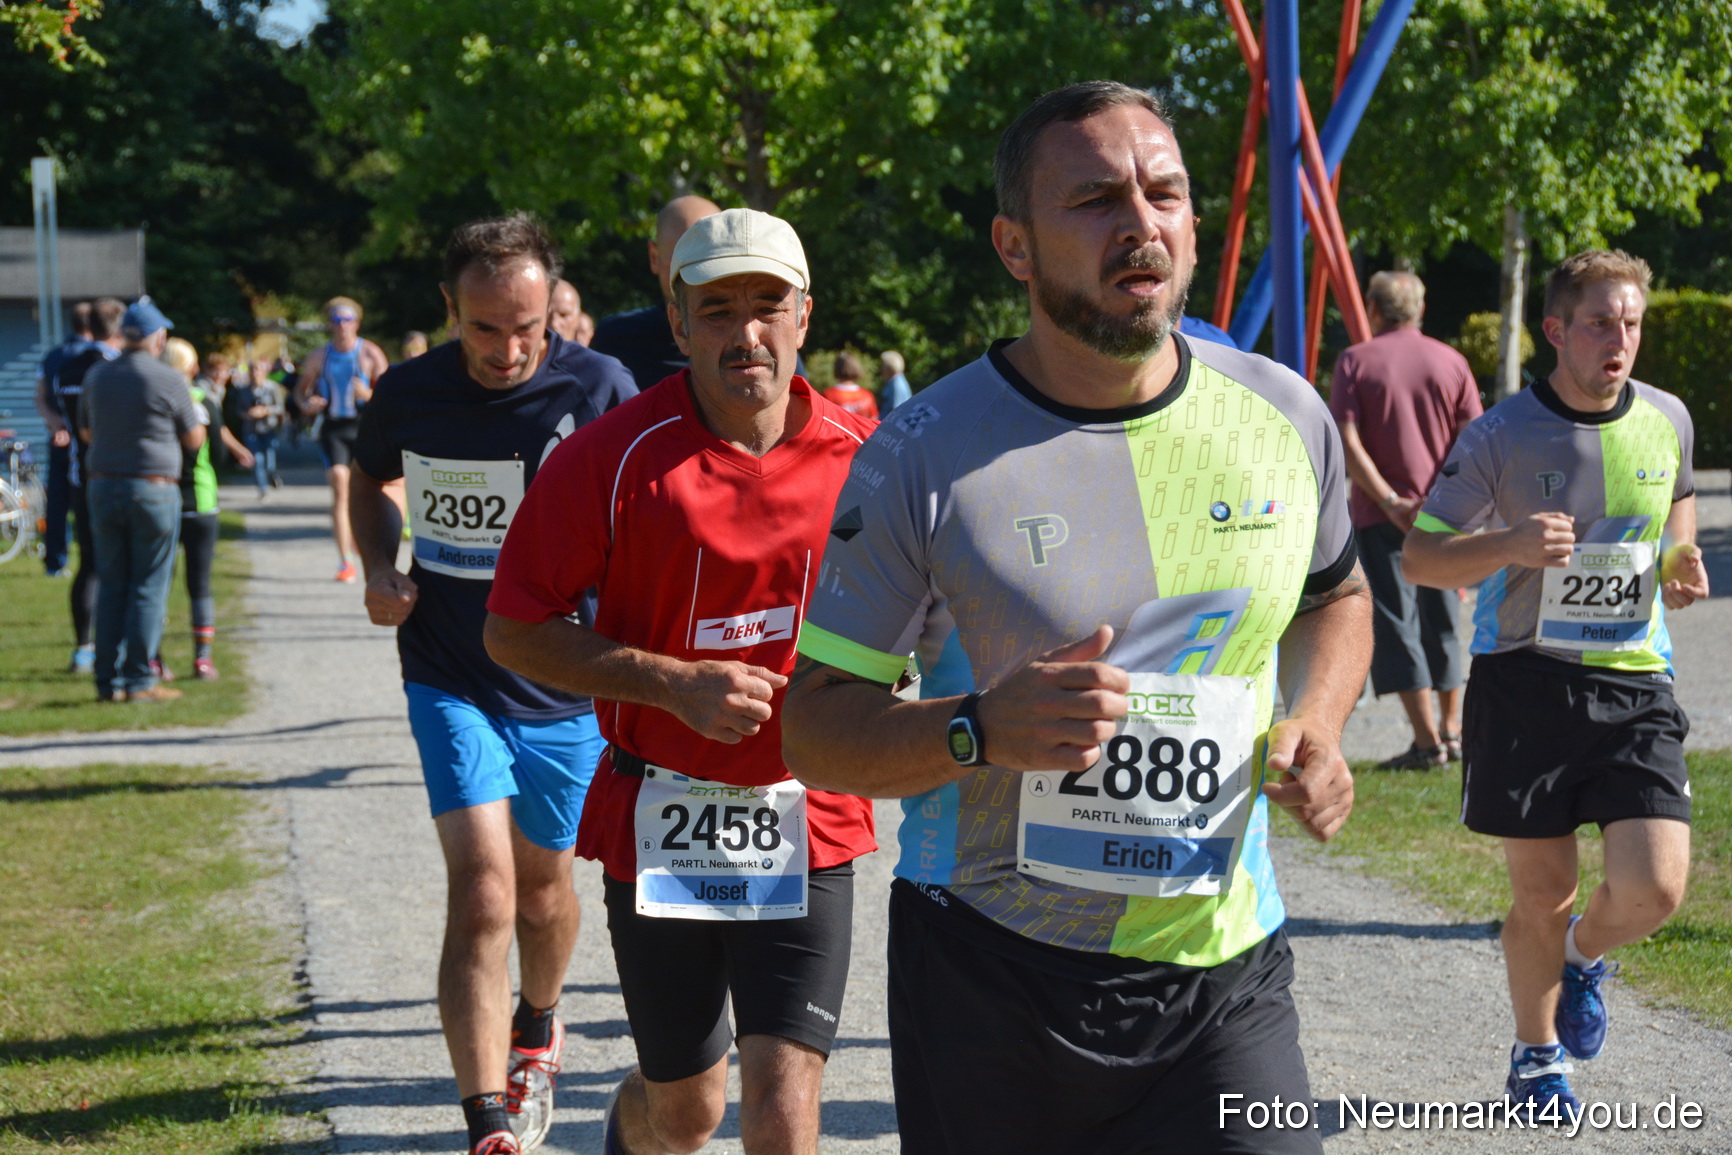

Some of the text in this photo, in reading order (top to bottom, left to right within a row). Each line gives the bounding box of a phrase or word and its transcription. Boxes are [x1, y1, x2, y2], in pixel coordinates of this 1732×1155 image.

[431, 469, 487, 484] BOCK
[422, 489, 508, 530] 2392
[432, 528, 490, 543] PARTL Neumarkt
[1213, 522, 1277, 534] PARTL NEUMARKT
[437, 547, 495, 567] Andreas
[1581, 553, 1631, 567] BOCK
[1560, 574, 1642, 607] 2234
[721, 619, 767, 641] DEHN
[1581, 625, 1619, 640] Peter
[1125, 692, 1197, 717] OCK
[1035, 780, 1043, 792] A
[660, 803, 782, 851] 2458
[1071, 808, 1191, 828] PARTL Neumarkt
[643, 840, 651, 849] B
[671, 859, 758, 869] PARTL Neumarkt
[1102, 840, 1173, 871] Erich
[694, 880, 749, 901] Josef
[806, 1001, 836, 1024] benger
